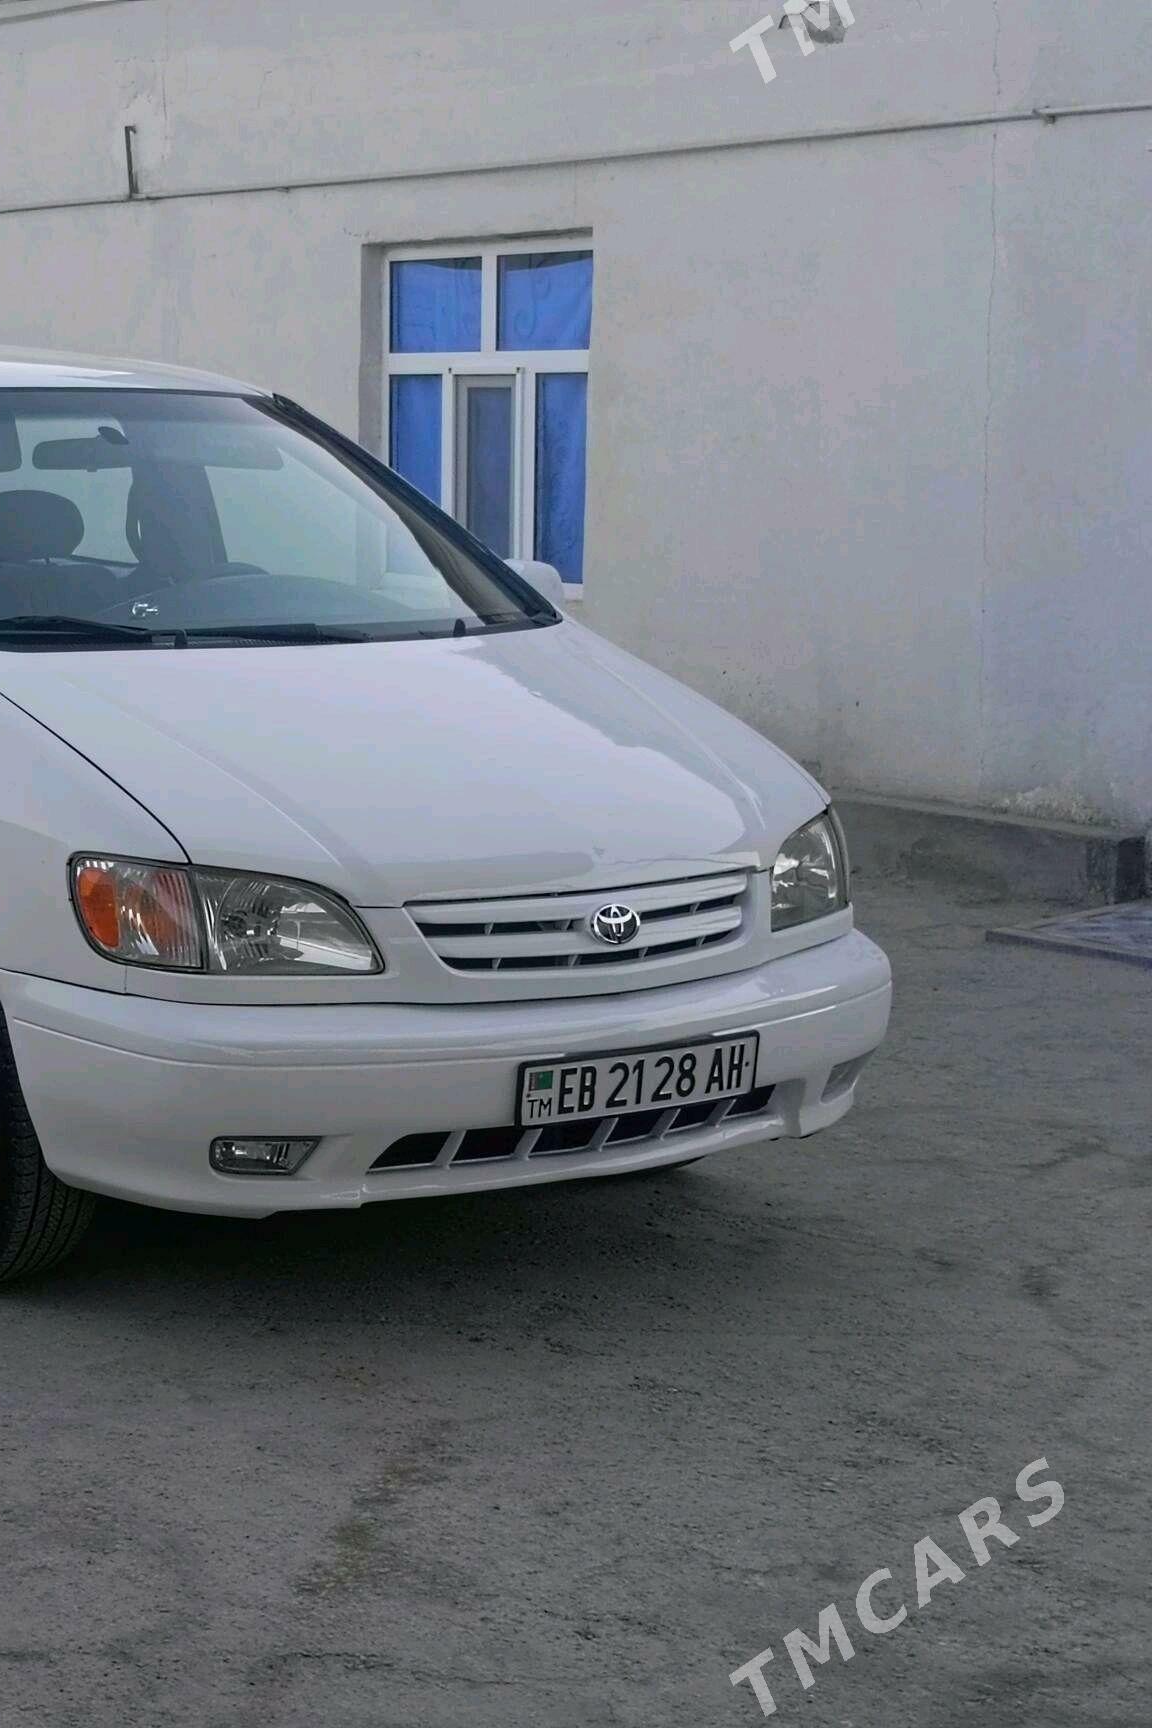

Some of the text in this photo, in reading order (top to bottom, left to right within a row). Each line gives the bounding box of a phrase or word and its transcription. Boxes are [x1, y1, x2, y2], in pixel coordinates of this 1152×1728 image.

[557, 1043, 746, 1115] EB 2128 AH
[527, 1097, 552, 1119] TM
